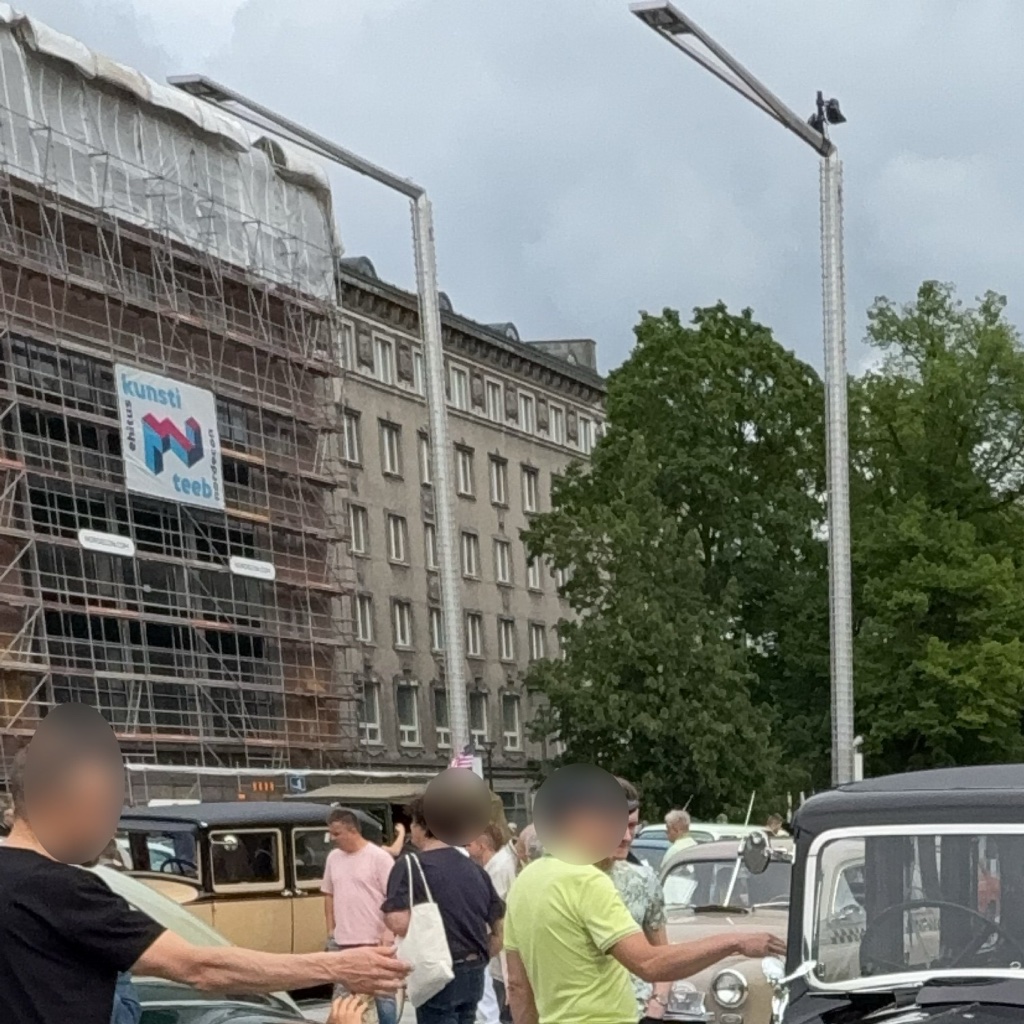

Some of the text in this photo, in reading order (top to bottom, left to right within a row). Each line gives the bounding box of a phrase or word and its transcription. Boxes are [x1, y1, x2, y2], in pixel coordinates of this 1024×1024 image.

[121, 374, 181, 409] kunsti
[125, 400, 136, 451] ehitus
[172, 473, 213, 499] teeb
